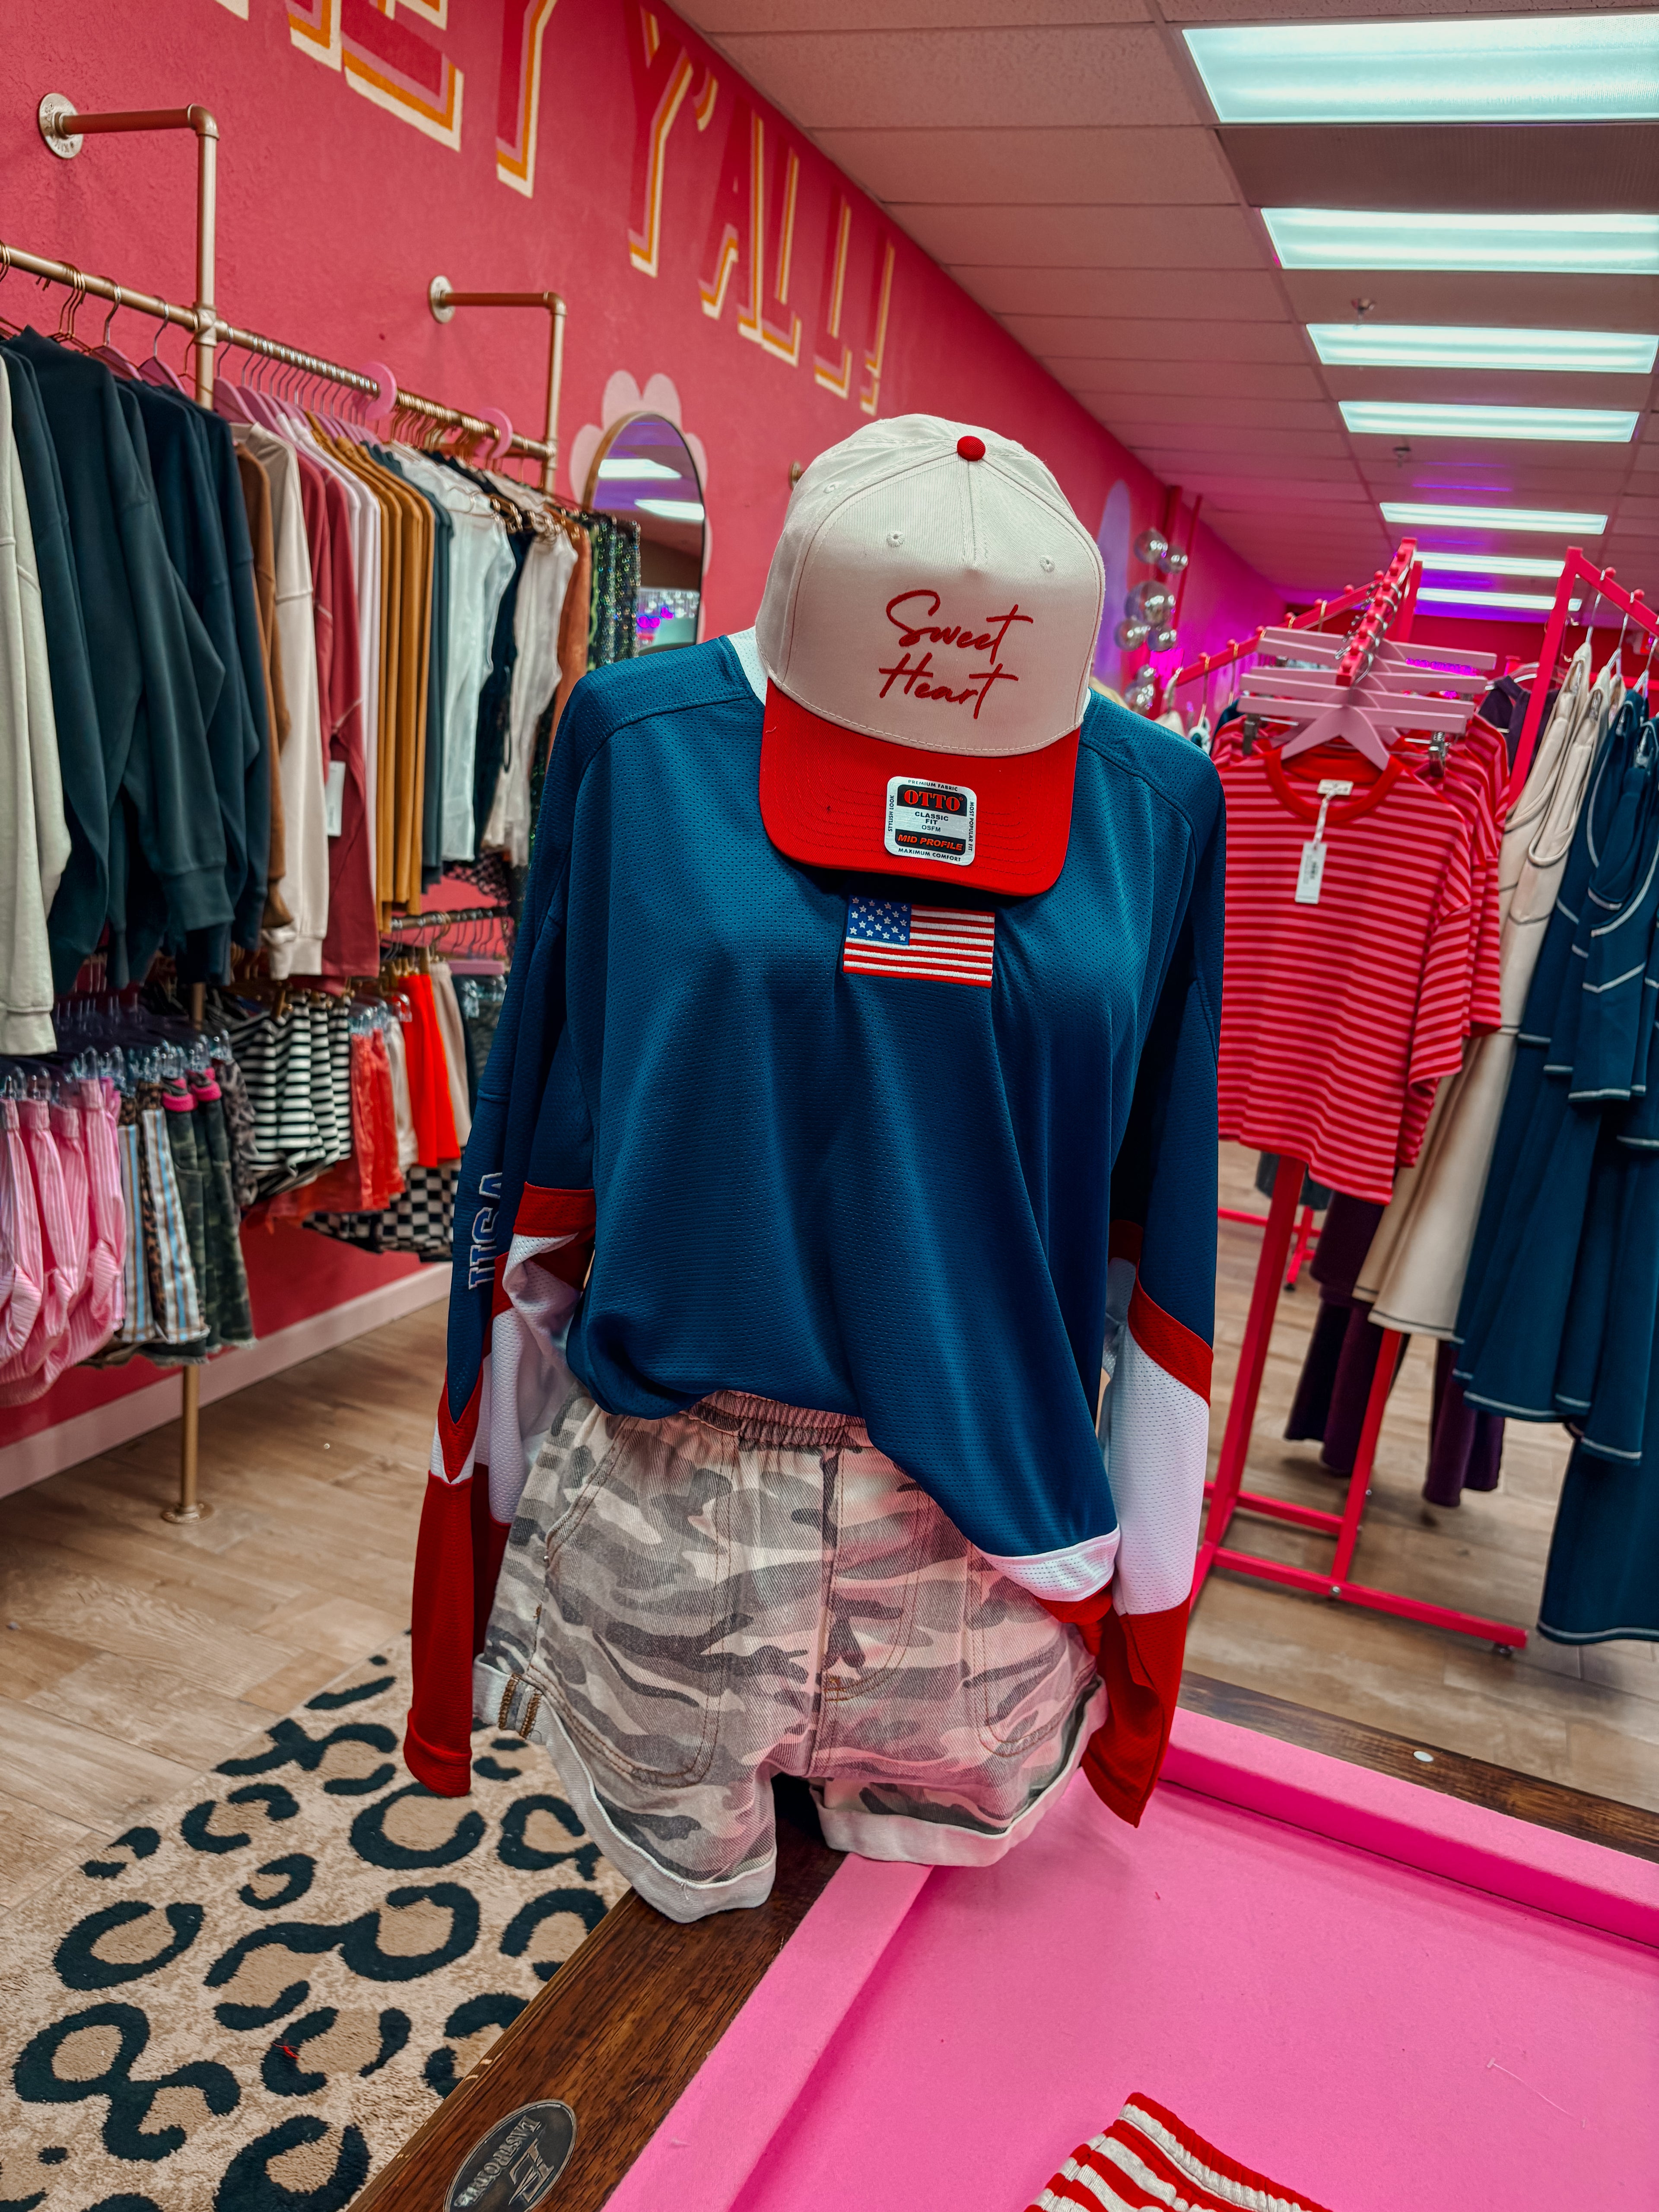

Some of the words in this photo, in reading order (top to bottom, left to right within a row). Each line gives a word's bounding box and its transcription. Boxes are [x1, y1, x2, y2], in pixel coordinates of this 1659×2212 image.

[886, 589, 1033, 665] Sweet
[878, 652, 1019, 719] Heart
[908, 779, 936, 788] PREMIUM
[938, 783, 958, 791] FABRIC
[904, 789, 960, 811] OTTO
[915, 811, 949, 821] CLASSIC
[898, 834, 918, 843] MID
[919, 837, 963, 851] PROFILE
[898, 848, 931, 856] MAXIMUM
[932, 853, 961, 862] COMFORT
